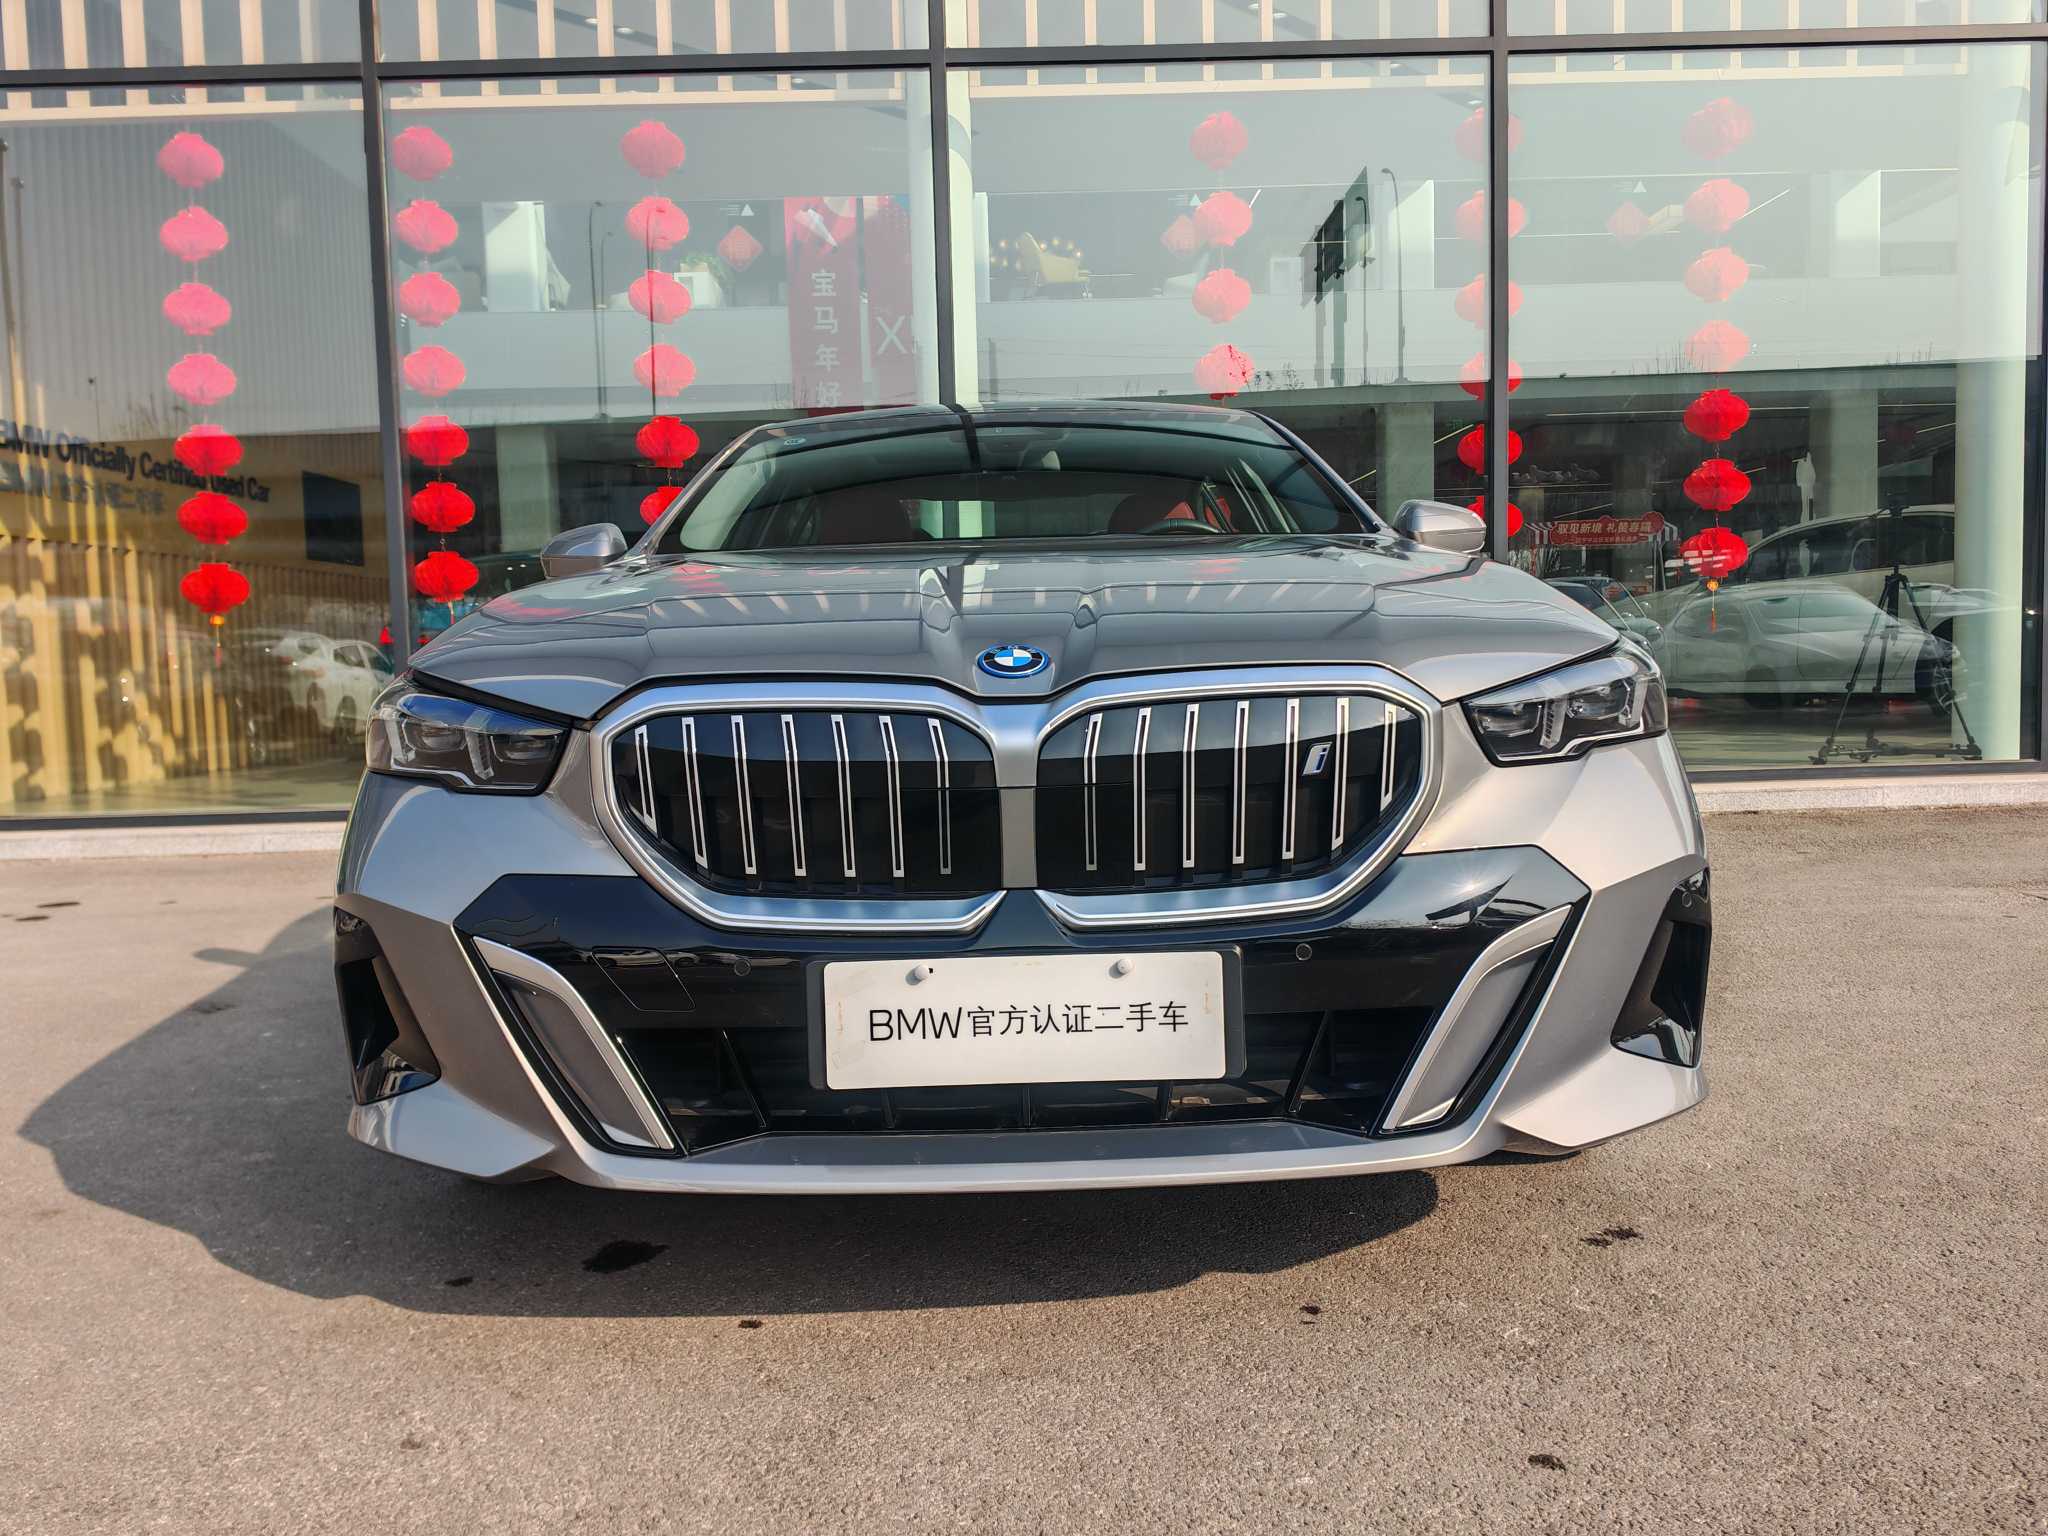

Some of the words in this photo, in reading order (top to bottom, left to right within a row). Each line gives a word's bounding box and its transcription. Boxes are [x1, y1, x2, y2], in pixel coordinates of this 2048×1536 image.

[869, 1000, 1189, 1042] BMW官方认证二手车
